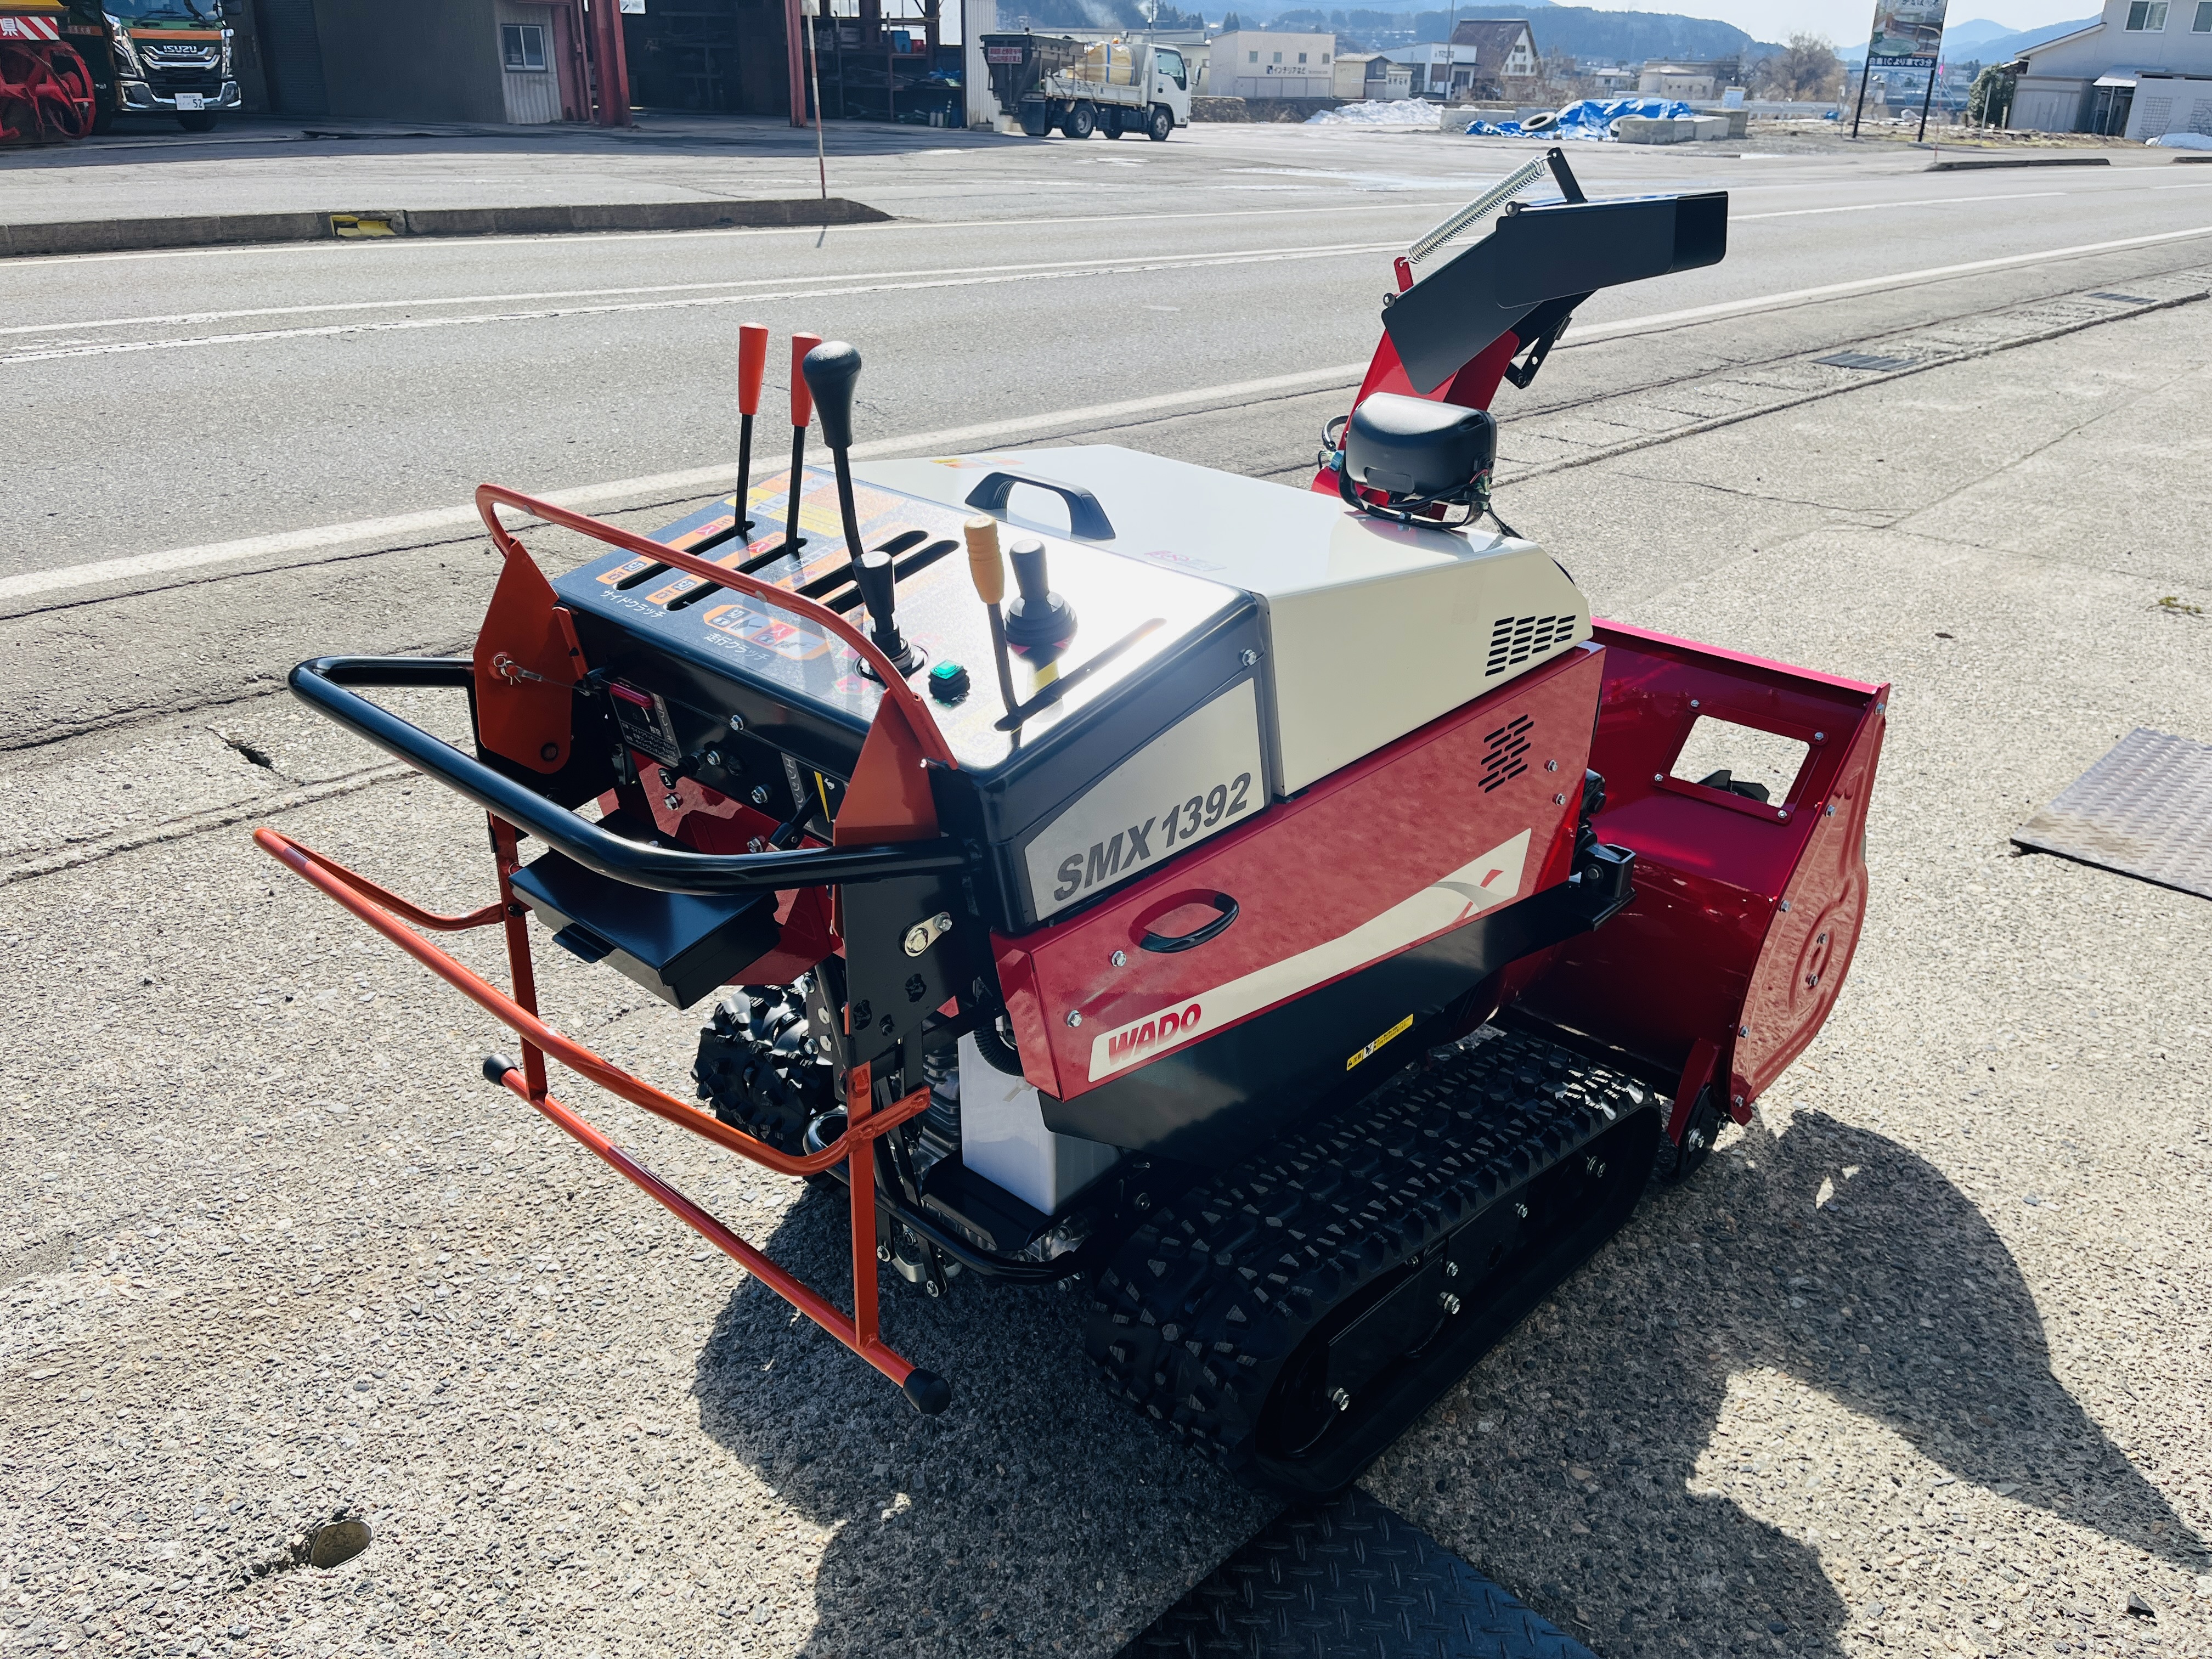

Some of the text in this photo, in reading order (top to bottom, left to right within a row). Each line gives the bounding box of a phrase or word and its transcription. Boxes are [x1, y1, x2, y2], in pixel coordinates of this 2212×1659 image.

[0, 18, 18, 37] 県
[193, 99, 203, 108] 52
[697, 526, 714, 535] 入
[748, 544, 768, 553] 入
[626, 561, 645, 572] 切
[675, 580, 695, 591] 切
[600, 590, 667, 618] サイドクラッチ
[727, 607, 744, 618] 切
[768, 625, 788, 636] 入
[703, 633, 770, 661] 走行クラッチ
[1053, 772, 1251, 901] SMX 1392
[1108, 1003, 1201, 1066] WADO
